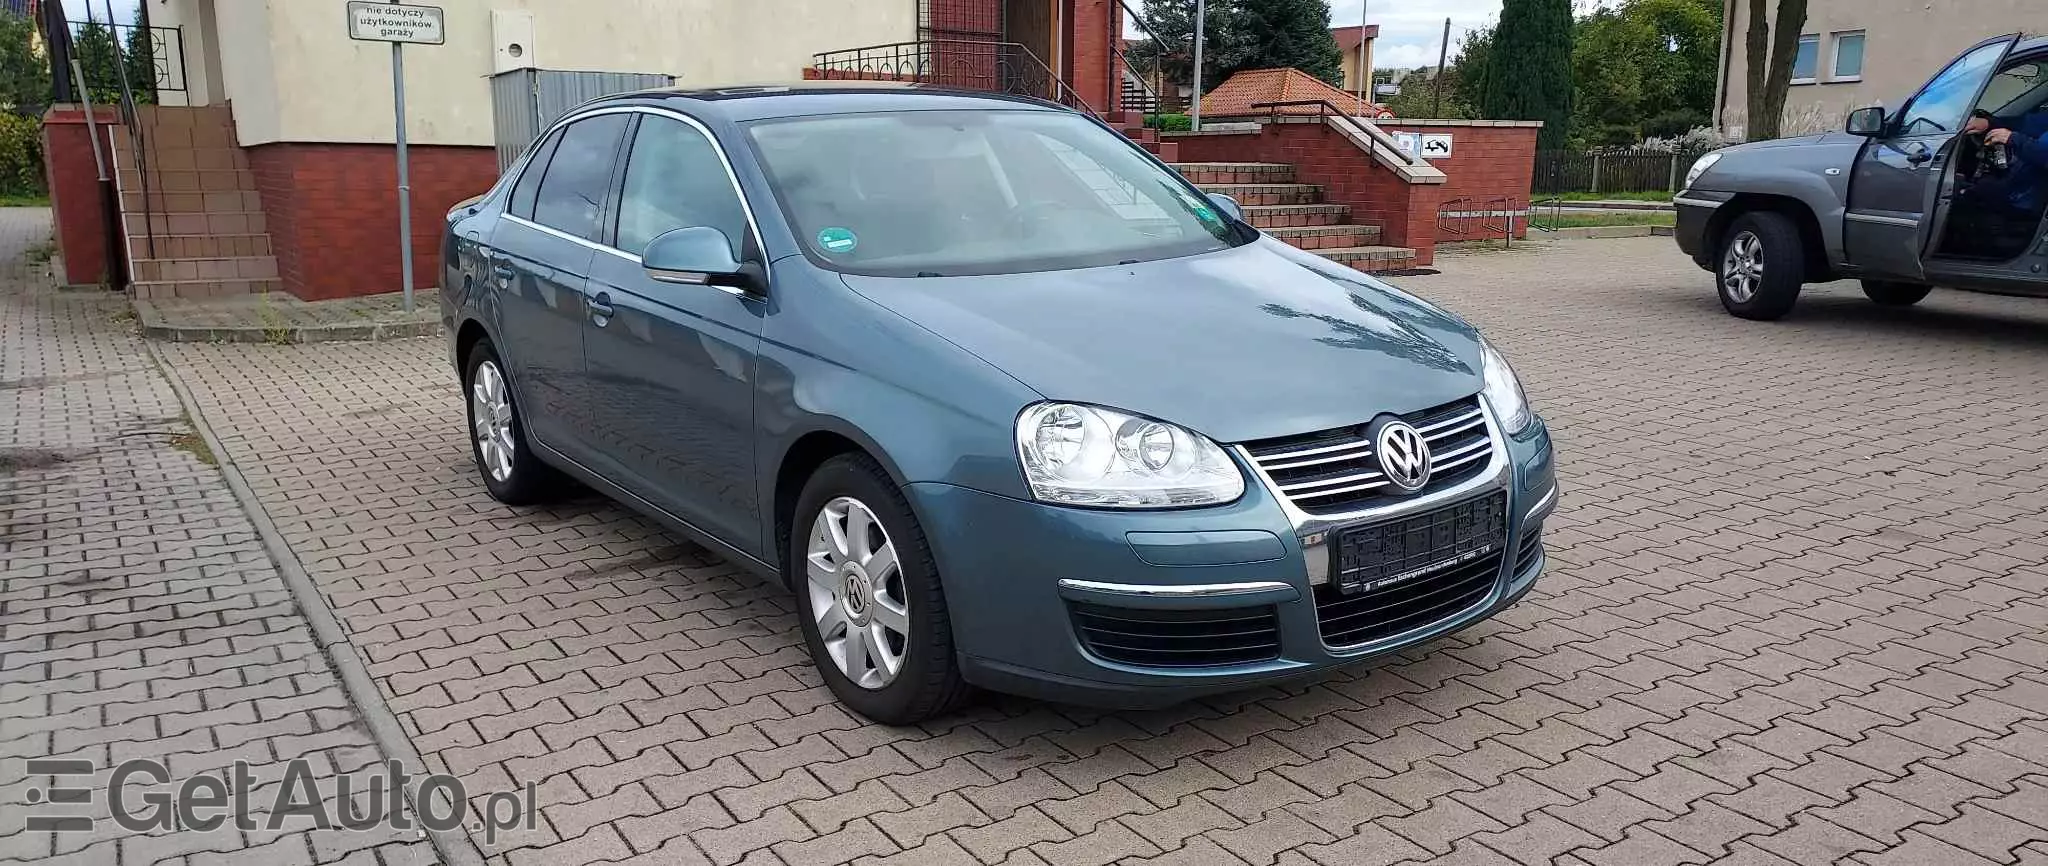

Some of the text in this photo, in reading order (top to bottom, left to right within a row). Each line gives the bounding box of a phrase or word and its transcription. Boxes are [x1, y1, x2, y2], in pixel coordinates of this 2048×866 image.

[385, 7, 424, 18] dotyczy
[360, 18, 432, 28] użytkowników
[381, 28, 414, 37] garaży
[1380, 423, 1428, 482] VW
